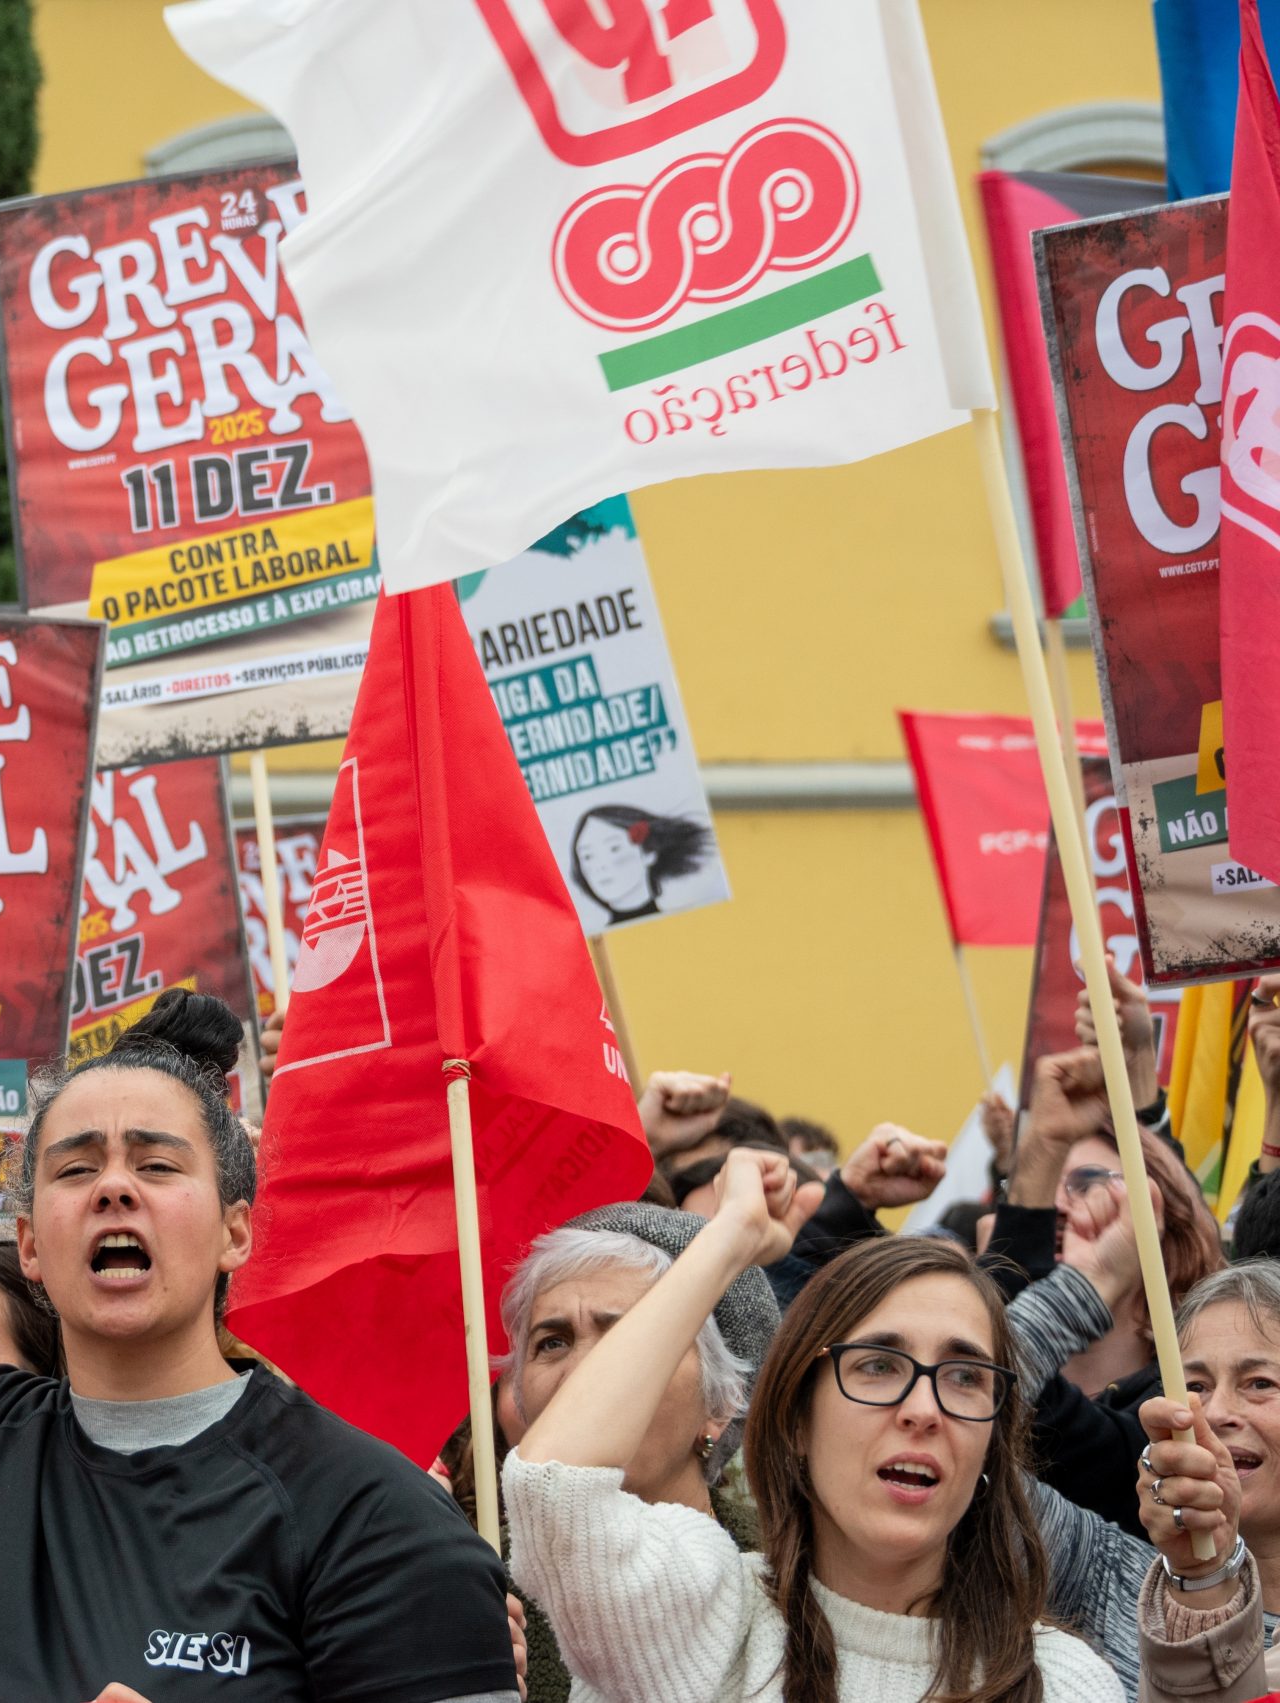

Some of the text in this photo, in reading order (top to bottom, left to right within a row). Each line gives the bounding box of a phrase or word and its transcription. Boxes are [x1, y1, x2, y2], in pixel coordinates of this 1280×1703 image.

[220, 189, 257, 216] 24
[221, 214, 259, 231] HORAS
[43, 300, 354, 453] GERA
[207, 409, 265, 445] 2025
[121, 438, 336, 534] 11 DEZ.
[169, 528, 279, 576] CONTRA
[102, 540, 360, 623] O PACOTE LABORAL
[134, 604, 255, 656] RETROCESSO
[258, 602, 270, 623] E
[272, 595, 288, 618] À
[290, 572, 383, 615] EXPLORA
[477, 587, 643, 671] ARIEDADE
[552, 660, 599, 704] DA
[1166, 809, 1219, 845] NÃO
